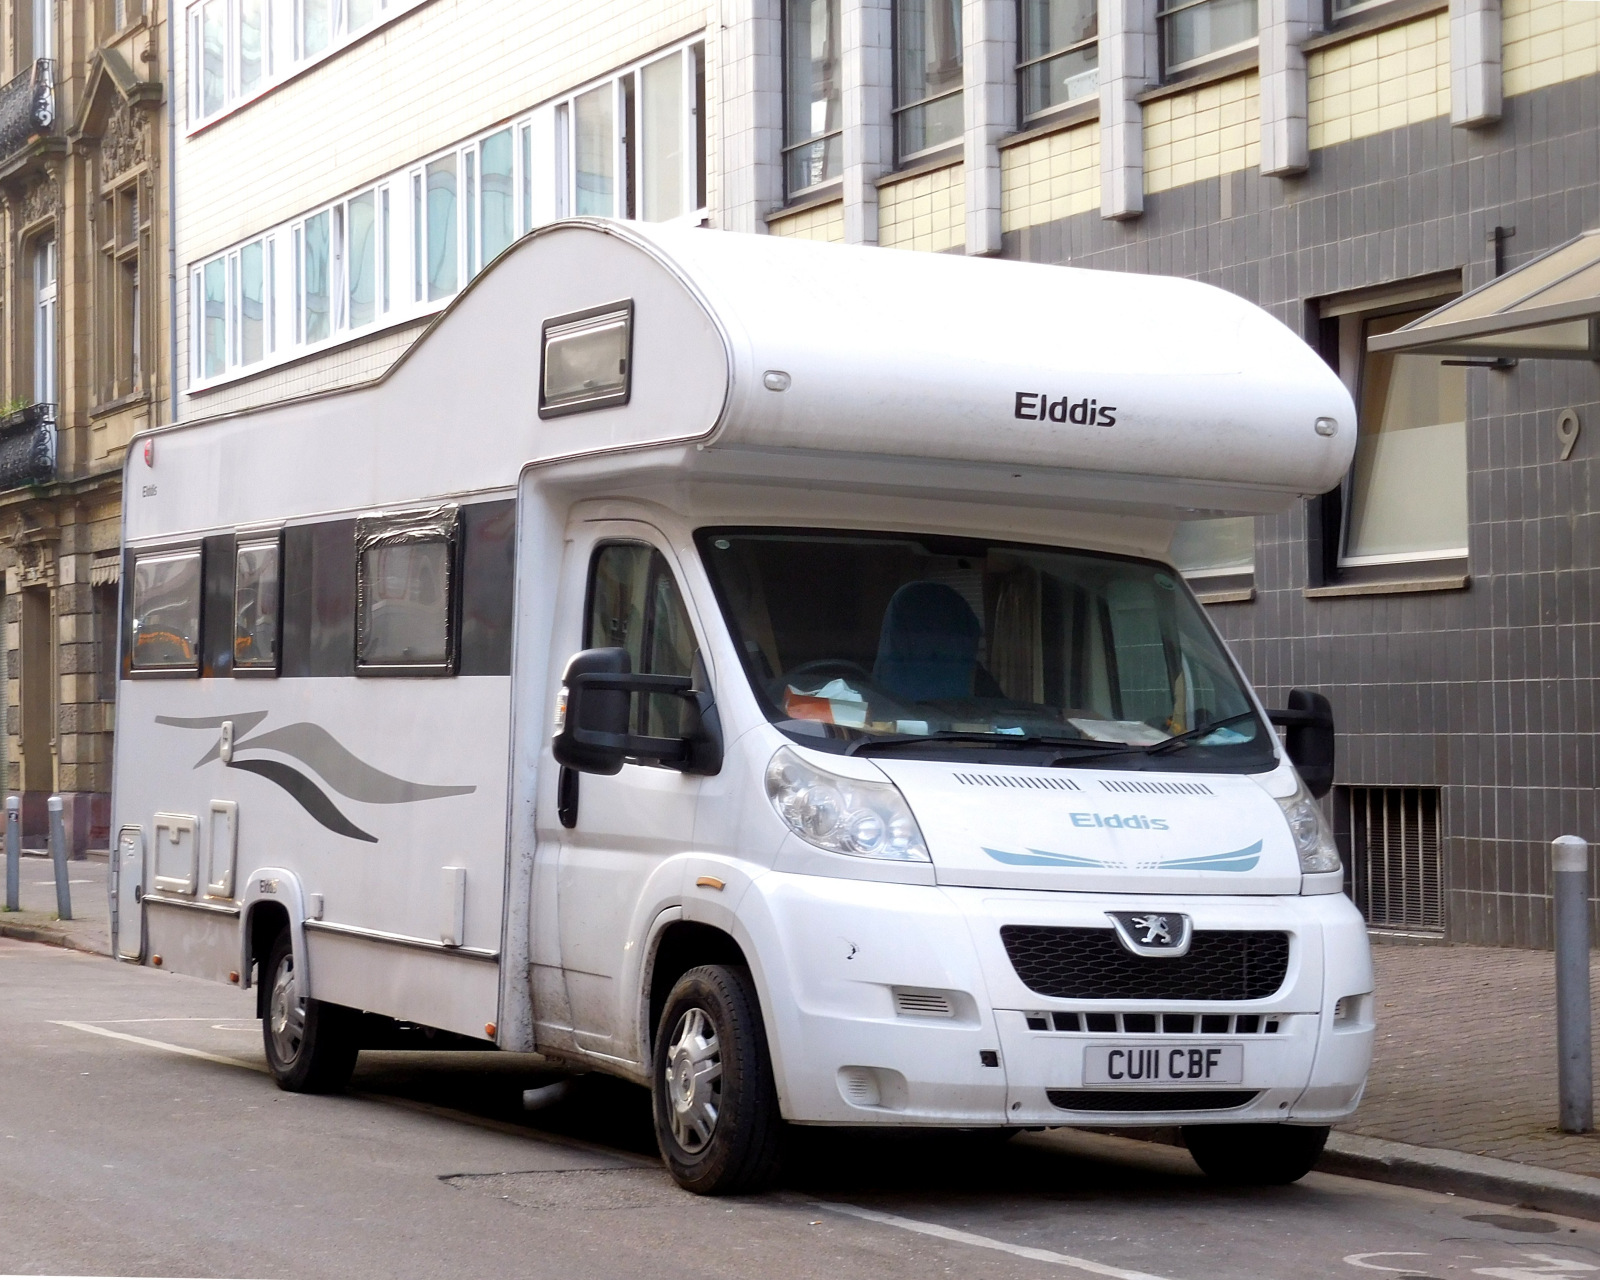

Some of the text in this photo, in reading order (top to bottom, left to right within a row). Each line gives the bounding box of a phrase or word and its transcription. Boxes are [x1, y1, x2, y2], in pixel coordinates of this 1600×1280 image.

[1015, 391, 1117, 428] Elddis
[1557, 408, 1580, 461] 9
[1068, 812, 1170, 831] Elddis
[260, 879, 278, 894] Eldd
[1108, 1048, 1222, 1080] CU11 CBF
